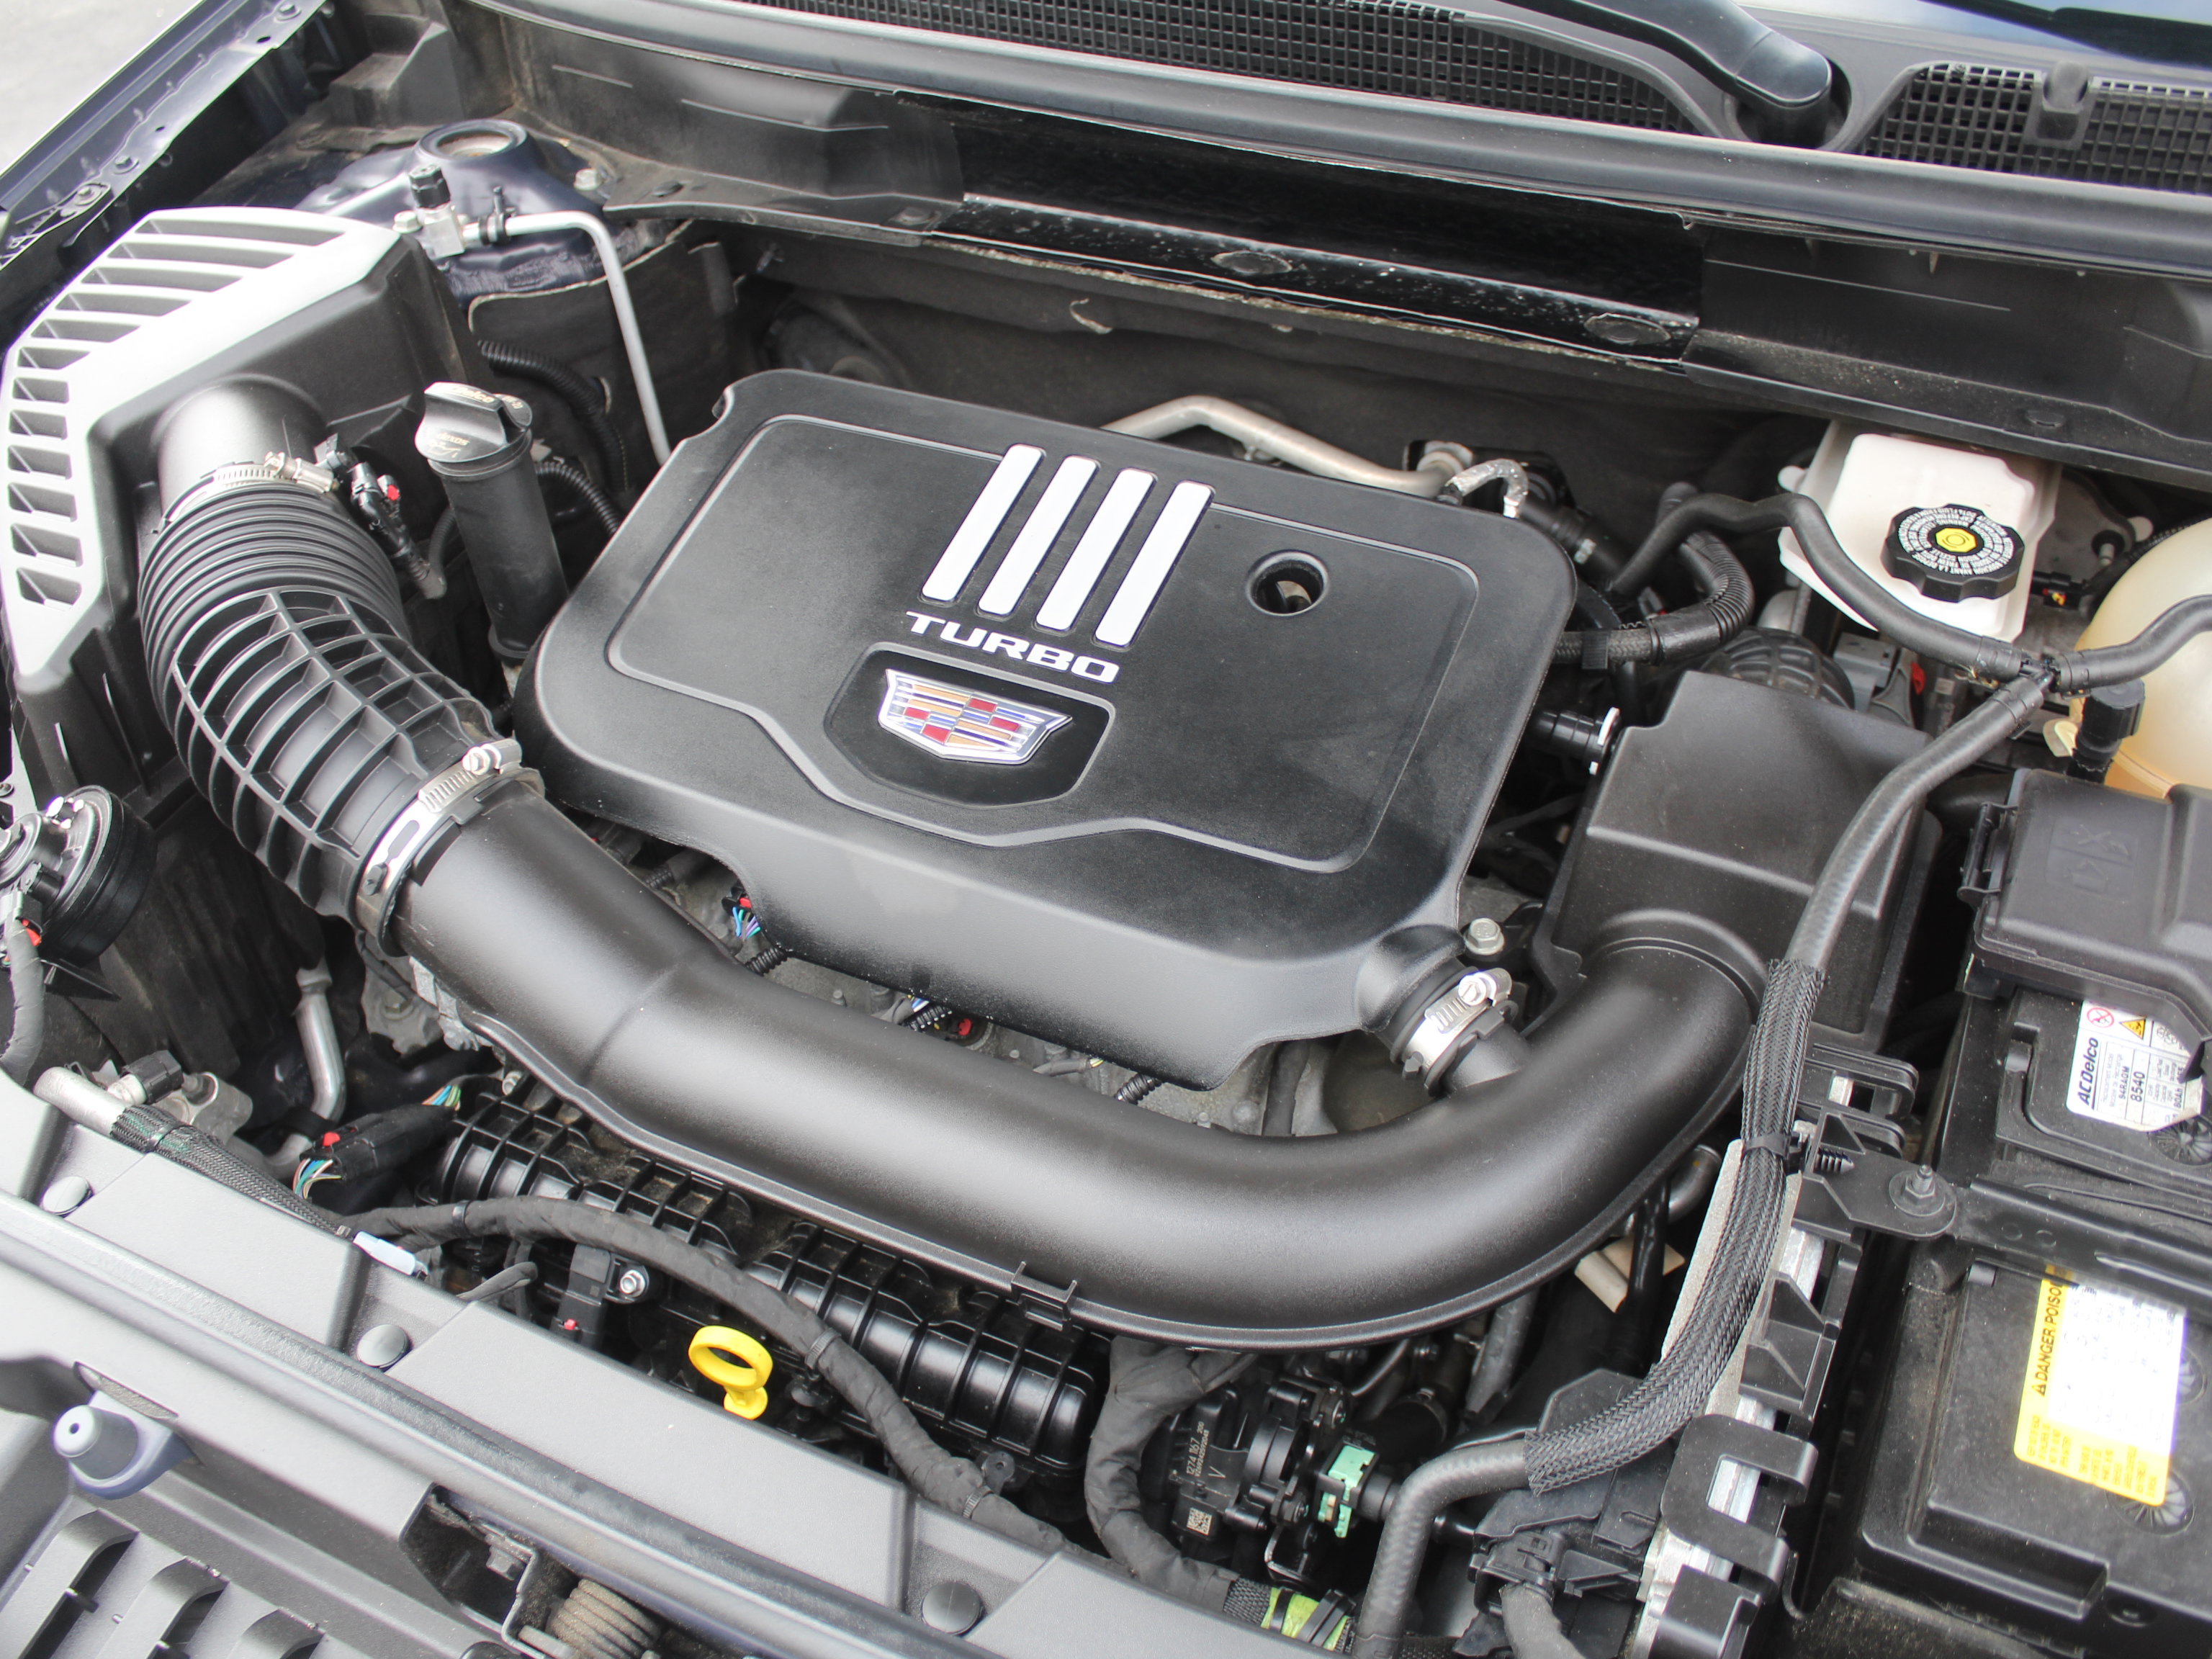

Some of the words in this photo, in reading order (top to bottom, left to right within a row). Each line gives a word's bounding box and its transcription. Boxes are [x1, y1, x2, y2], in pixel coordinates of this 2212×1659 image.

[906, 611, 1120, 683] TURBO
[2077, 1037, 2098, 1105] ACDelco
[2131, 1071, 2145, 1102] 8540
